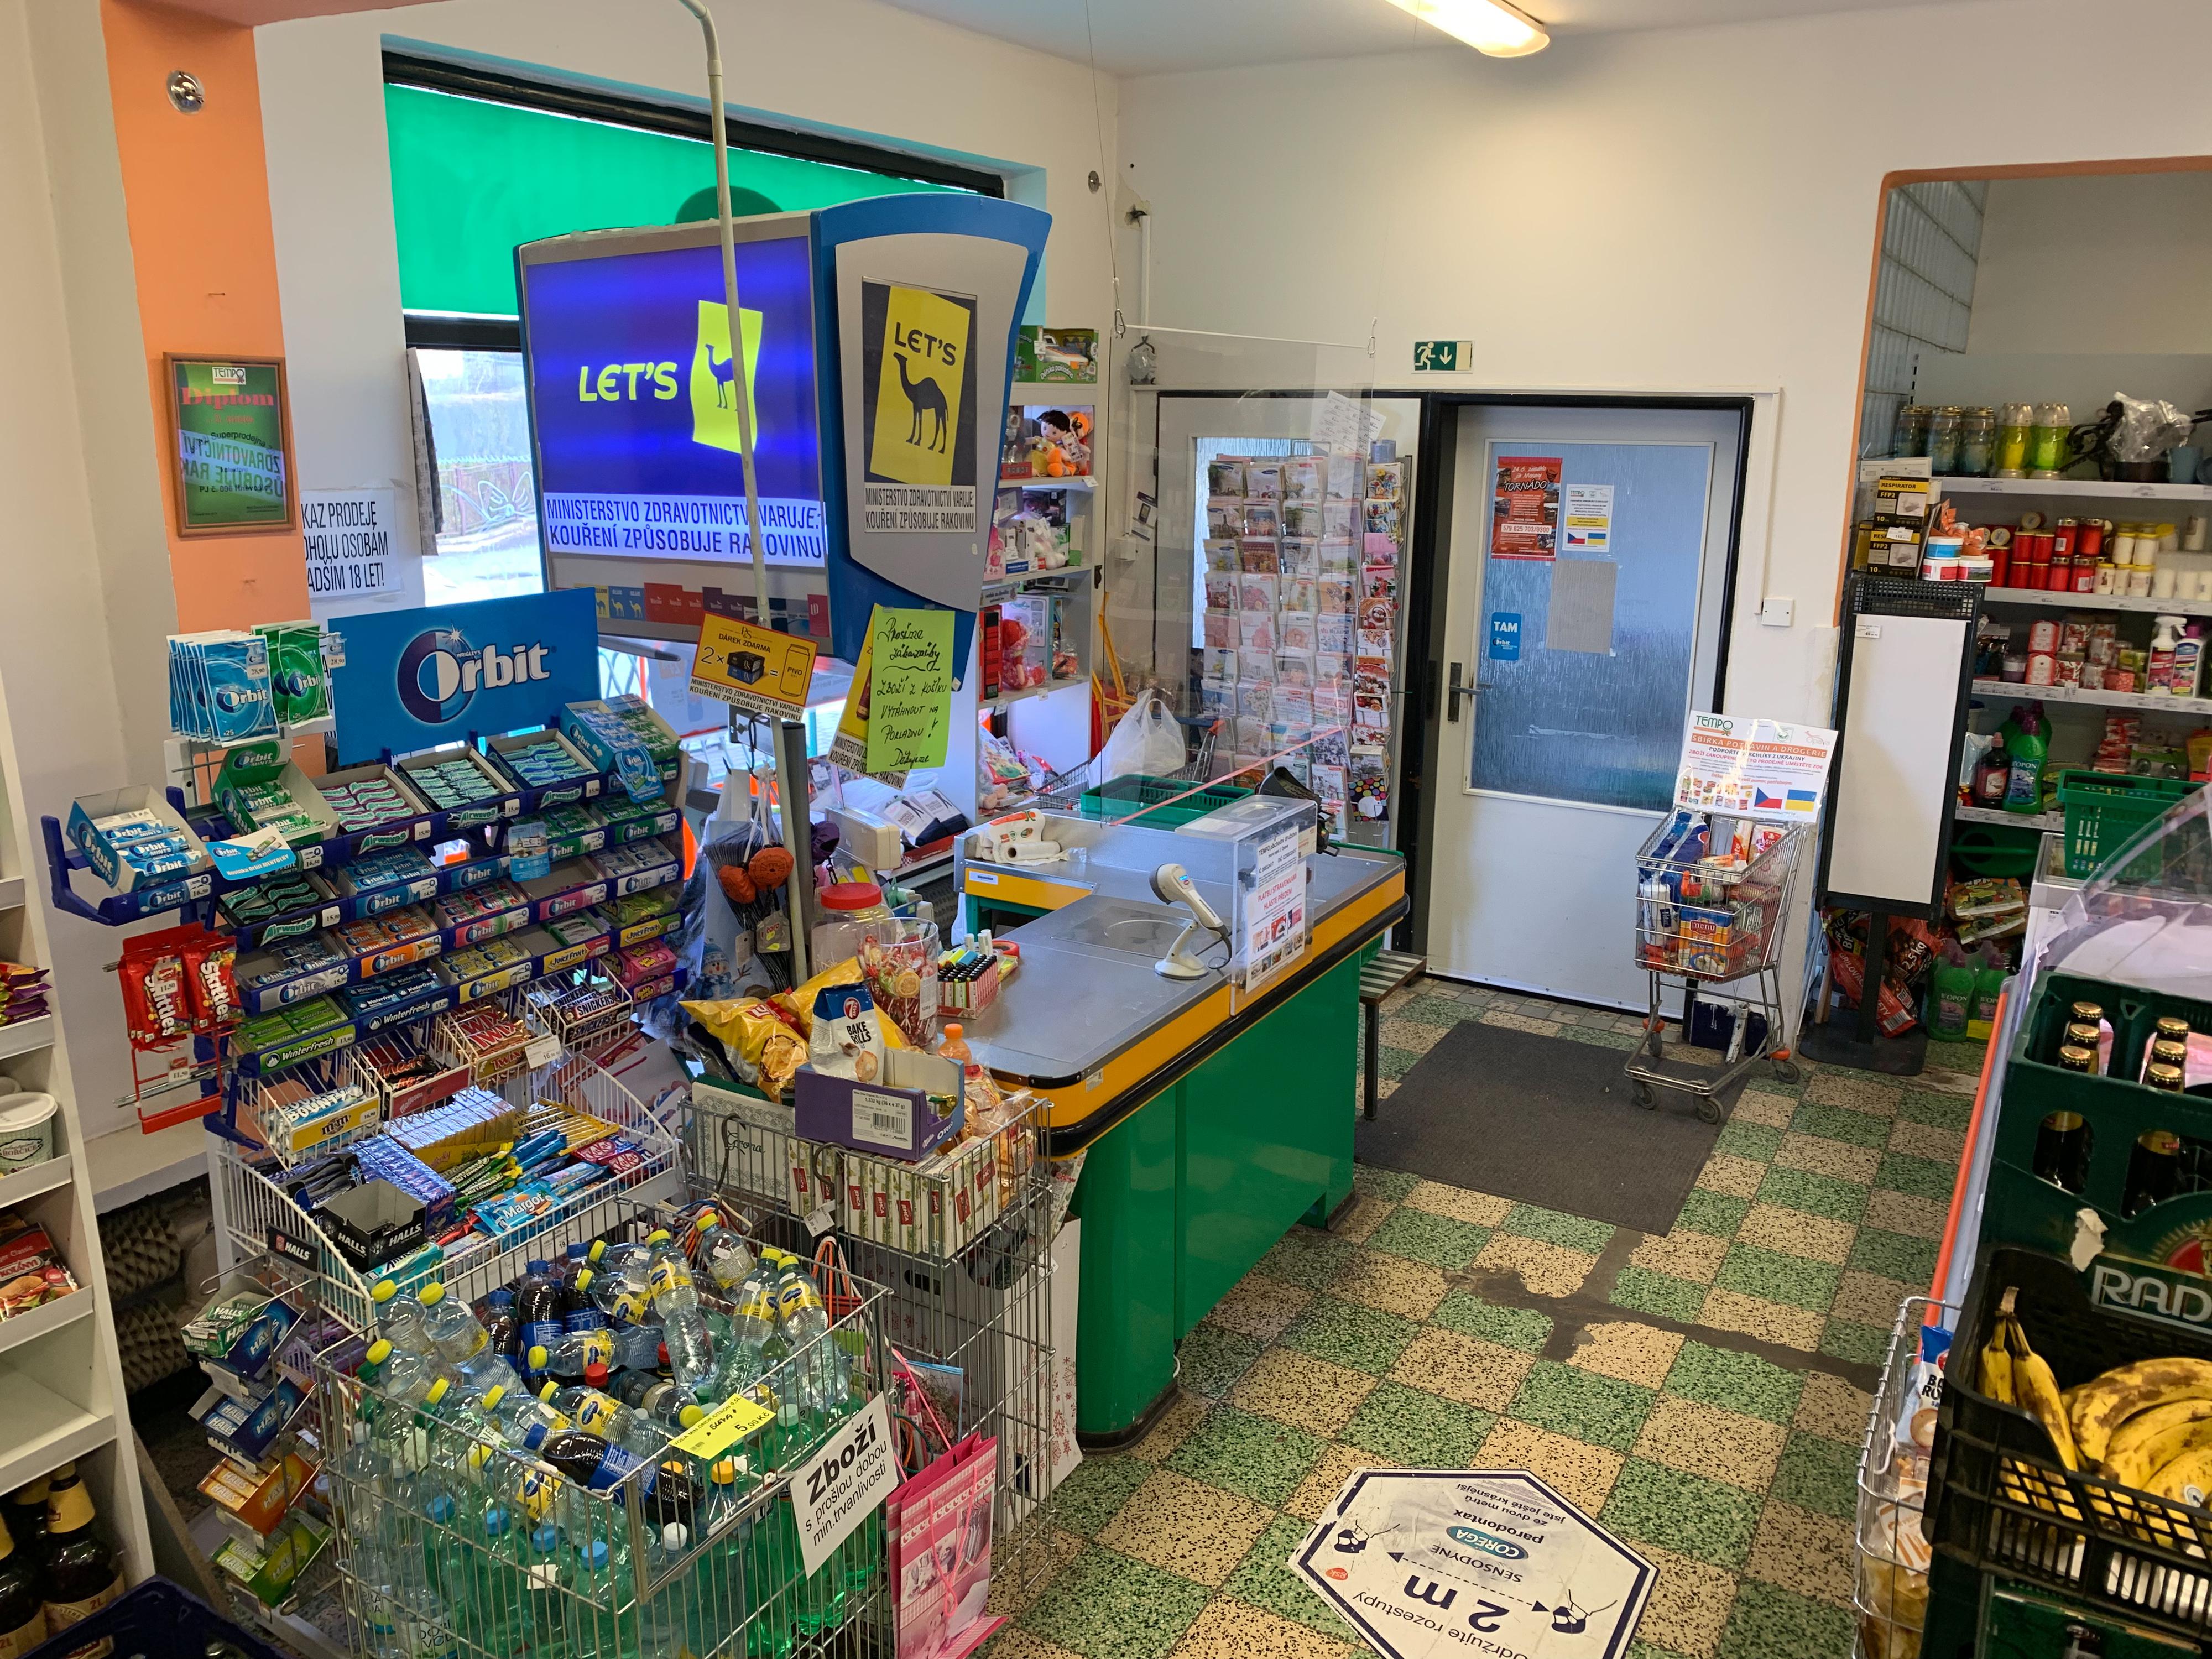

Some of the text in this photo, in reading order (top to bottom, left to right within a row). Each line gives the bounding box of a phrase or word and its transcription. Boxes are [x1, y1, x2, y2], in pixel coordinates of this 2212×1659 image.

[894, 321, 957, 367] LET'S
[213, 367, 244, 379] TEMPO
[578, 360, 678, 403] LET'S
[181, 387, 274, 410] Diplom
[1503, 479, 1548, 492] TORNÁDO
[865, 486, 974, 508] MINISTERSTVO ZDRAVOTNICTVÍ VARUJE:
[301, 500, 377, 529] KAZ PRODEJE
[546, 499, 822, 530] MINISTERSTVO ZDRAVOTNICTV VARUJE:
[865, 508, 974, 530] KOUŘENÍ ZPŮSOBUJE RAKOVINU
[342, 526, 389, 559] OSOBÁM
[549, 523, 618, 548] KOUŘENÍ
[623, 525, 723, 554] ZPŮSOBUJE
[307, 559, 385, 592] ADŠÍM 18 LET!
[1494, 621, 1518, 633] TAM
[718, 633, 771, 653] DÁREK ZDARMA
[1493, 638, 1511, 646] Orbit
[405, 636, 551, 712] Orbit
[787, 666, 803, 676] PIVO
[691, 678, 733, 695] MINISTERSTVO
[734, 689, 779, 707] ZDRAVOTNICTVÍ
[689, 685, 801, 722] KOUŘENÍ ZPŮSOBUJE RAKOVINU
[1696, 714, 1733, 731] TEMPO
[1692, 734, 1724, 747] SBÍRKA
[1780, 745, 1827, 758] DROGERIE
[1776, 753, 1806, 761] UKRAJINY
[1785, 760, 1812, 768] UMÍSTĚTE
[541, 787, 581, 805] Airwaves
[459, 807, 499, 825] Airwaves
[361, 830, 409, 851] Airwaves
[150, 847, 173, 856] MINTS
[148, 860, 183, 875] Orbit
[369, 895, 401, 913] Orbit
[265, 917, 314, 939] Airwaves
[625, 924, 659, 939] Juicy Fruit
[1693, 921, 1715, 931] menu
[374, 954, 406, 973] Orbit
[568, 948, 586, 961] Fruit
[1902, 941, 1927, 970] 2,5 kg
[160, 982, 176, 991] 11,50
[200, 961, 230, 1022] Skittles
[280, 982, 316, 1004] Orbit
[406, 980, 436, 993] Winterfresh
[383, 1001, 431, 1025] Winterfresh
[577, 994, 615, 1015] SNICKERS
[469, 1021, 518, 1050] TWIX
[846, 1021, 868, 1036] BAKE
[281, 1036, 335, 1062] Winterfresh
[287, 1090, 347, 1122] BOUNTY
[525, 1115, 564, 1133] KOFILA
[937, 1121, 954, 1140] OREO
[583, 1141, 613, 1159] KitKat
[612, 1153, 643, 1172] KitKat
[502, 1192, 547, 1219] Margot
[900, 1203, 910, 1223] JEMCA
[337, 1232, 367, 1256] HALLS
[389, 1224, 424, 1247] HALLS
[10, 1245, 34, 1258] Classic
[284, 1241, 311, 1261] HALLS
[2092, 1264, 2212, 1324] RAD
[214, 1306, 243, 1317] HALLS
[221, 1404, 249, 1422] HALLS
[600, 1413, 611, 1428] Citron
[758, 1410, 770, 1424] Kč
[208, 1416, 237, 1434] HALLS
[806, 1413, 877, 1507] Zboží
[222, 1471, 249, 1490] HALLS
[805, 1440, 887, 1532] s prošlou dobou
[813, 1461, 887, 1547] min.trvanlivosti
[1455, 1483, 1567, 1524] jste ještě krásnější
[1464, 1495, 1548, 1527] ze dvou metrů
[1453, 1508, 1545, 1545] parodontax
[1455, 1528, 1521, 1558] COREGA
[1430, 1543, 1524, 1583] SENSODYNE
[1329, 1569, 1347, 1580] gsk
[90, 1598, 105, 1609] 2L
[1352, 1591, 1444, 1634] rozestupy
[1403, 1574, 1511, 1634] 2 m
